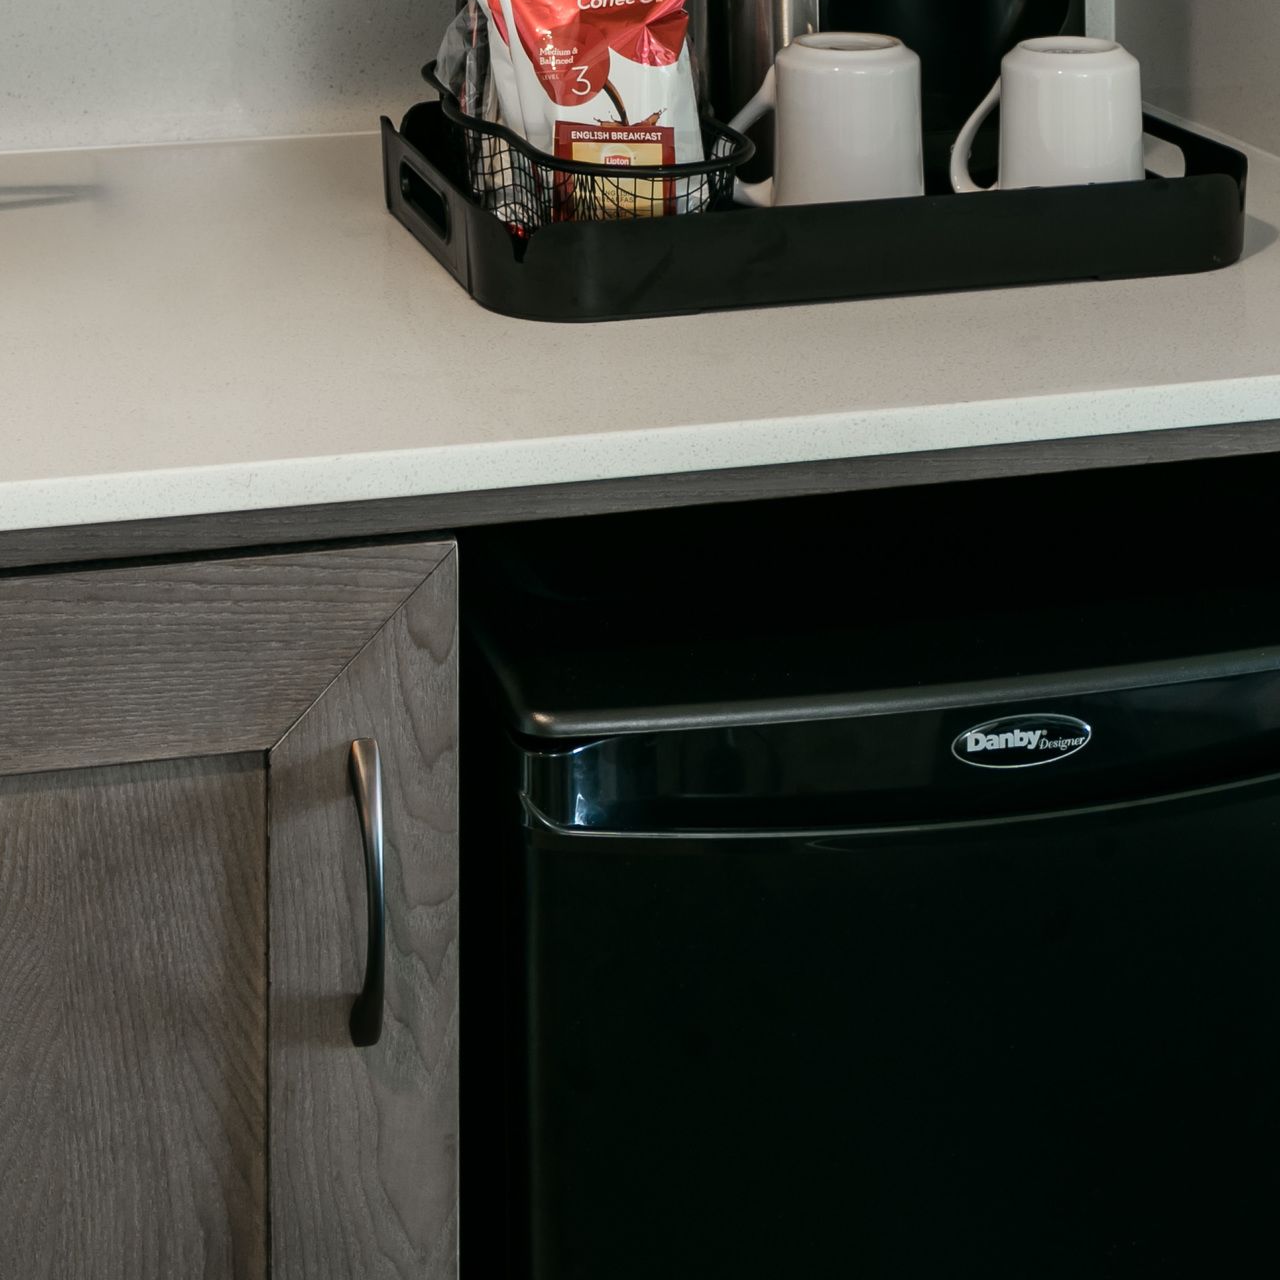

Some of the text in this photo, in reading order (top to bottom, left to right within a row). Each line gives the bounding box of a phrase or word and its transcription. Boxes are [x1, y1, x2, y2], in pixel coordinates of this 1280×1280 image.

[539, 47, 578, 56] Medium &
[539, 56, 574, 65] Balnced
[571, 65, 591, 96] 3
[571, 131, 662, 141] ENGLISH BREAKFAST
[967, 729, 1086, 753] Danby Designer
